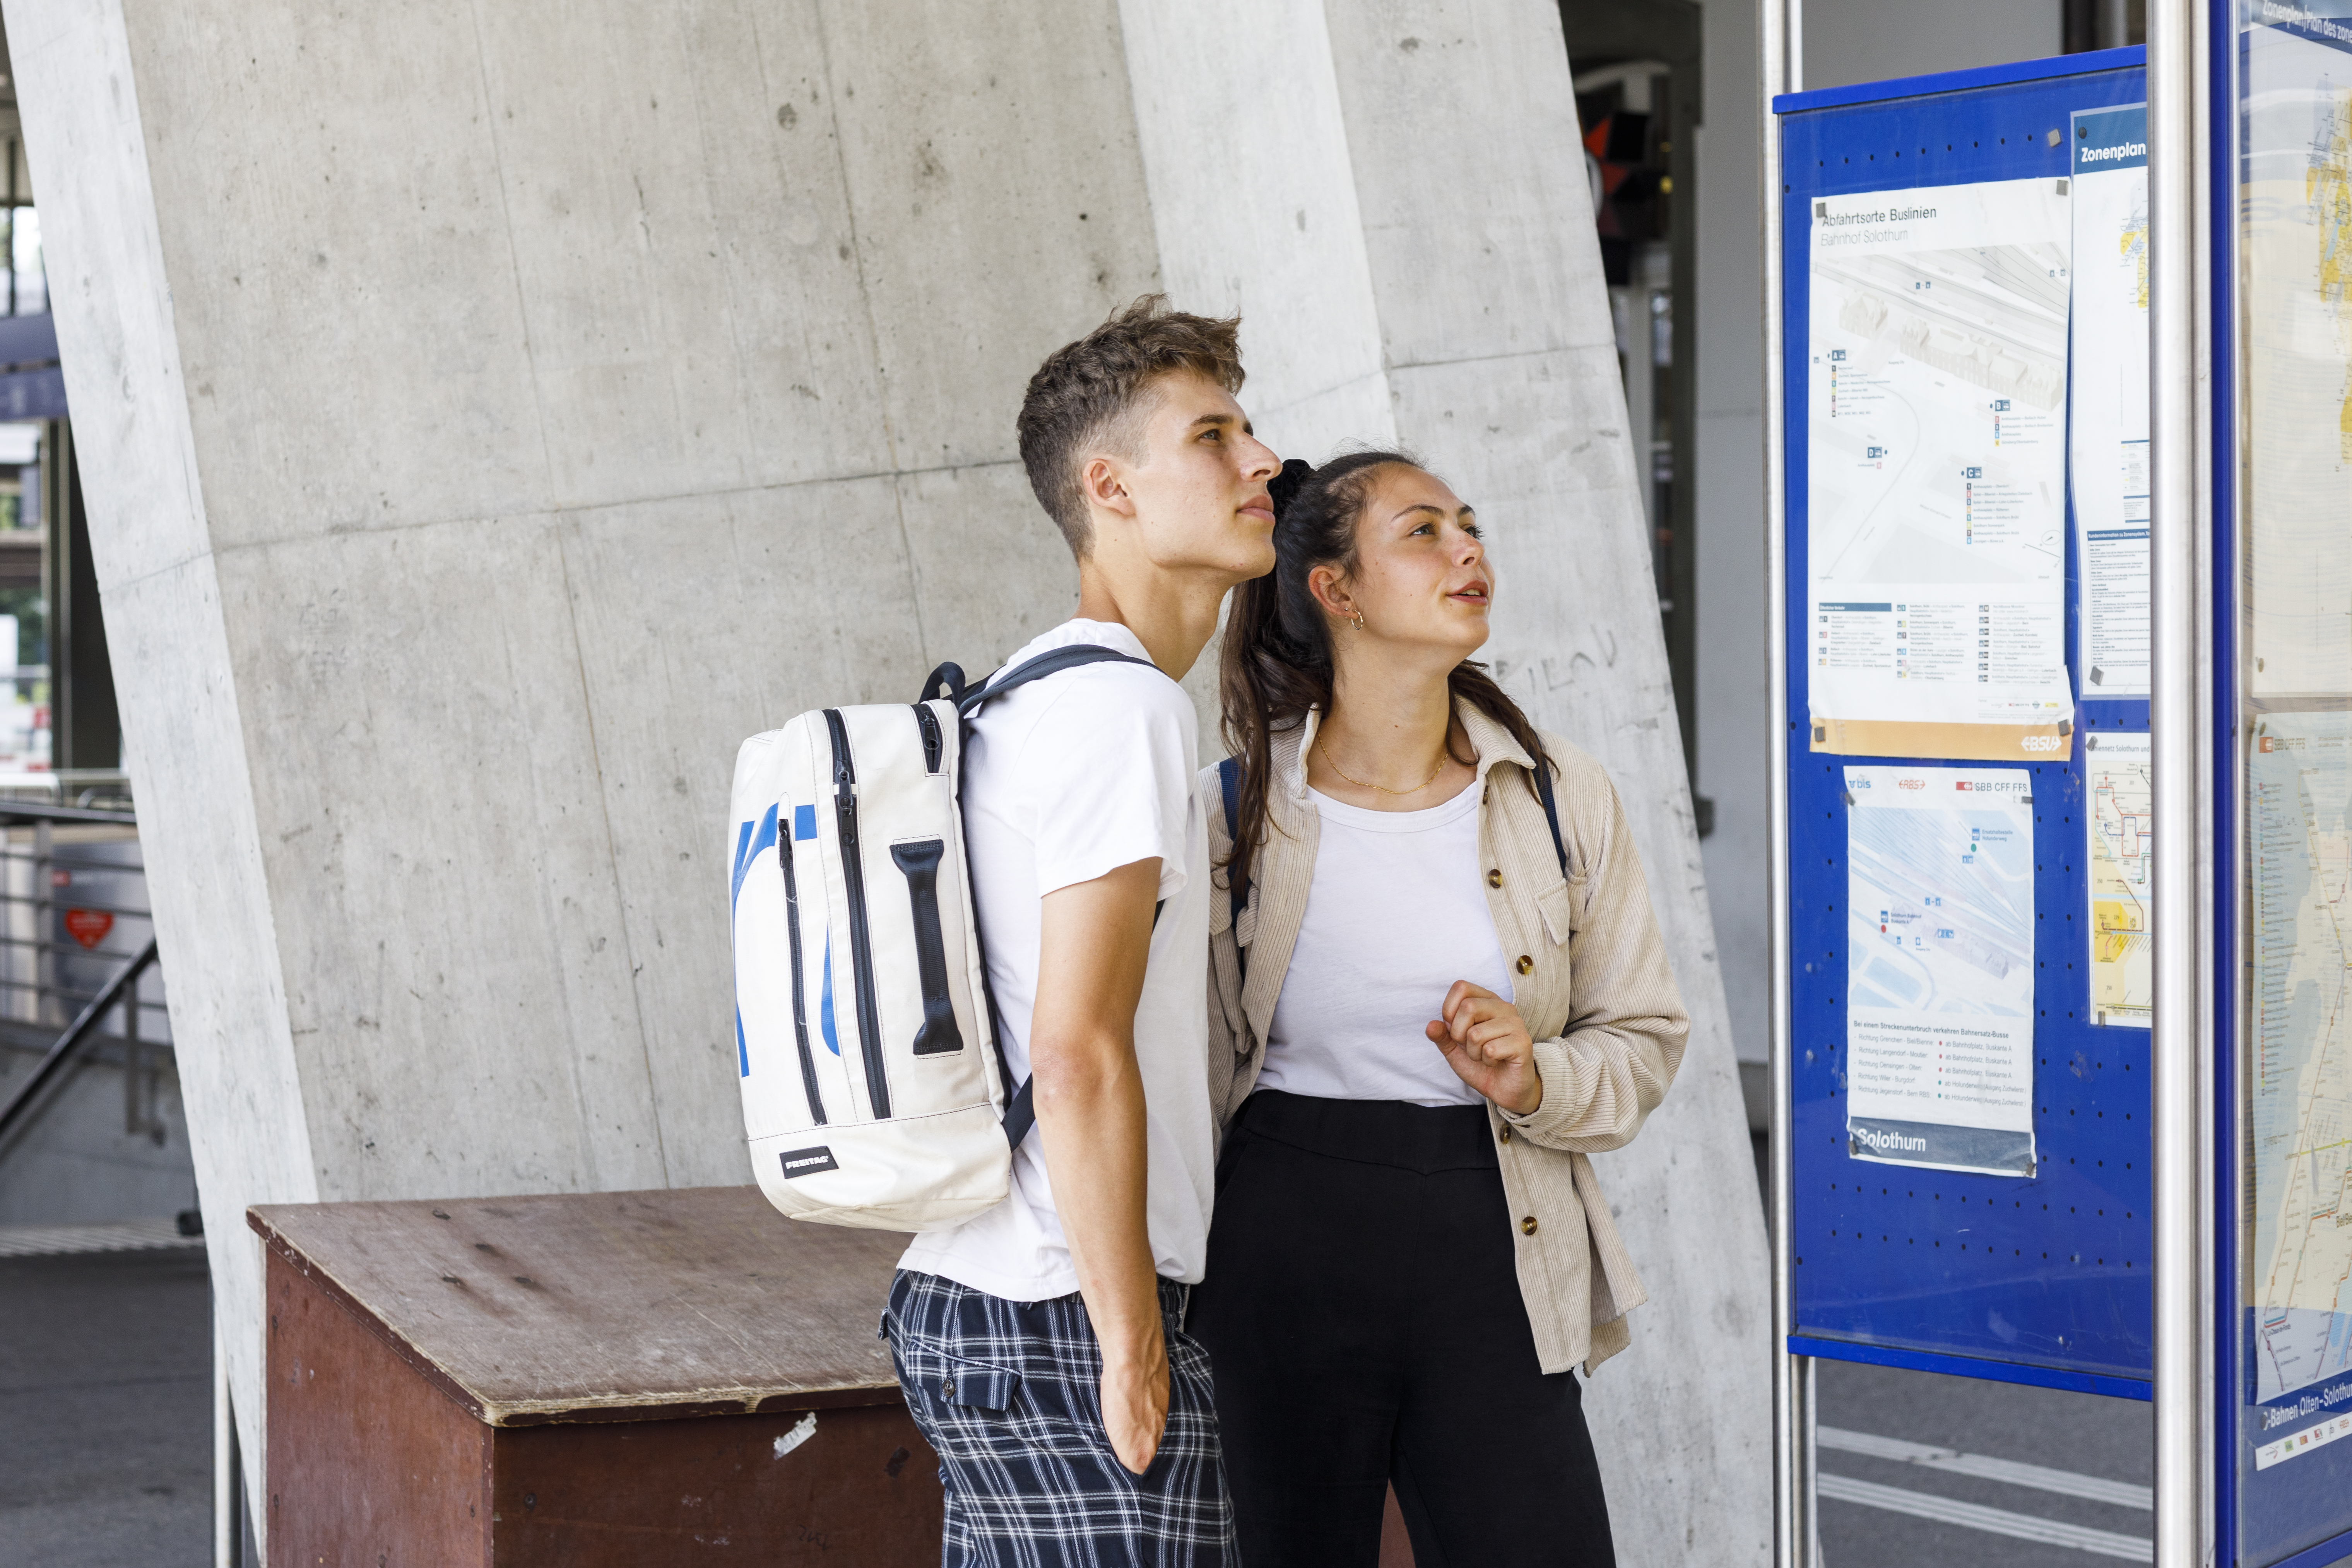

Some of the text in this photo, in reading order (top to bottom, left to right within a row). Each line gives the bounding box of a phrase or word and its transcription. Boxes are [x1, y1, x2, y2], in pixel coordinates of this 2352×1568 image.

[2323, 17, 2336, 38] des
[2081, 142, 2146, 162] Zonenplan
[1822, 206, 1936, 227] Abfahrtsorte Buslinien
[1821, 229, 1908, 246] Bahnhof Solothurn
[1996, 402, 2001, 410] B
[1975, 782, 1992, 791] SBB
[1995, 783, 2010, 792] CFF
[2013, 783, 2027, 792] FFS
[1880, 1022, 1931, 1033] Streckenunterbruch
[1933, 1027, 1959, 1035] verkehren
[1961, 1028, 2009, 1038] Bahnersatz-Busse
[1859, 1034, 1878, 1043] Richtung
[1859, 1046, 1878, 1056] Richtung
[1880, 1048, 1906, 1057] Langendorf
[1858, 1060, 1878, 1069] Richtung
[1880, 1061, 1904, 1070] Oensingen
[1858, 1072, 1878, 1082] Richtung
[1858, 1086, 1878, 1095] Richtung
[1858, 1128, 1926, 1152] Solothurn
[785, 1156, 829, 1169] FREITAG
